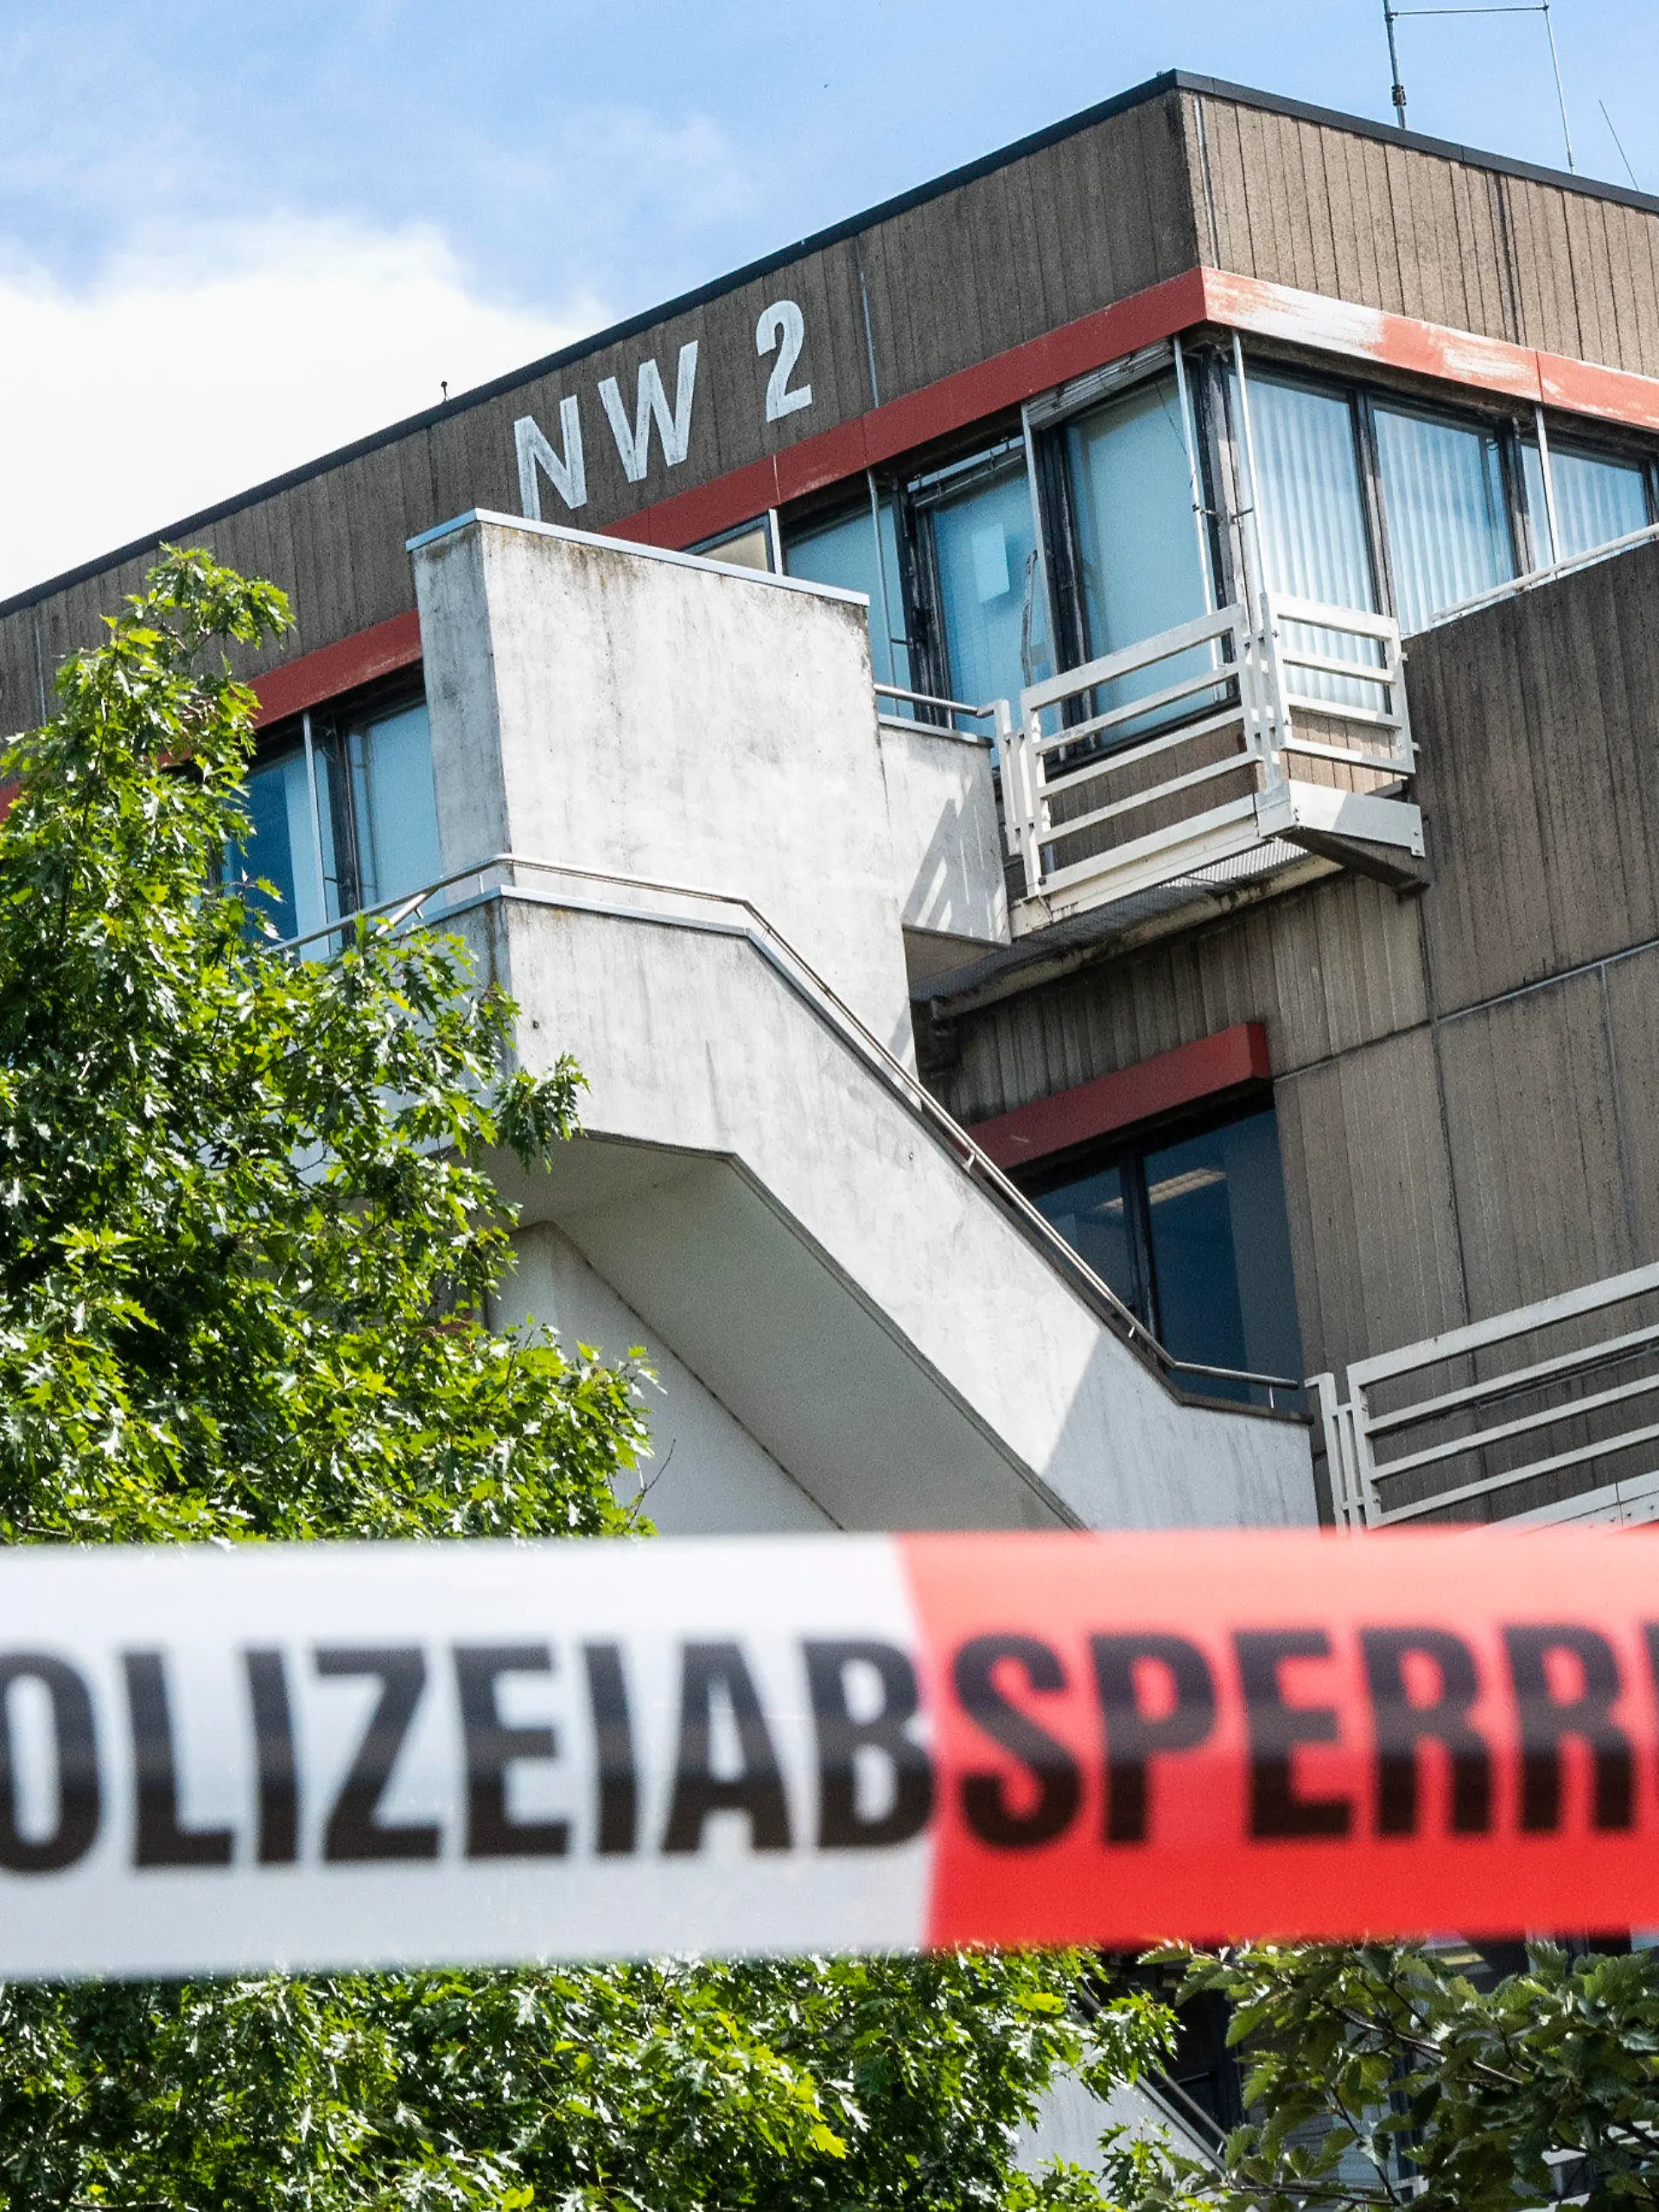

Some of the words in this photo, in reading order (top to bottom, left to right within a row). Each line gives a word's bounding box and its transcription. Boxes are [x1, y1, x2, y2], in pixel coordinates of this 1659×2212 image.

[514, 340, 698, 521] NW
[756, 300, 813, 423] 2
[0, 1624, 1659, 1875] OLIZEIABSPERR
